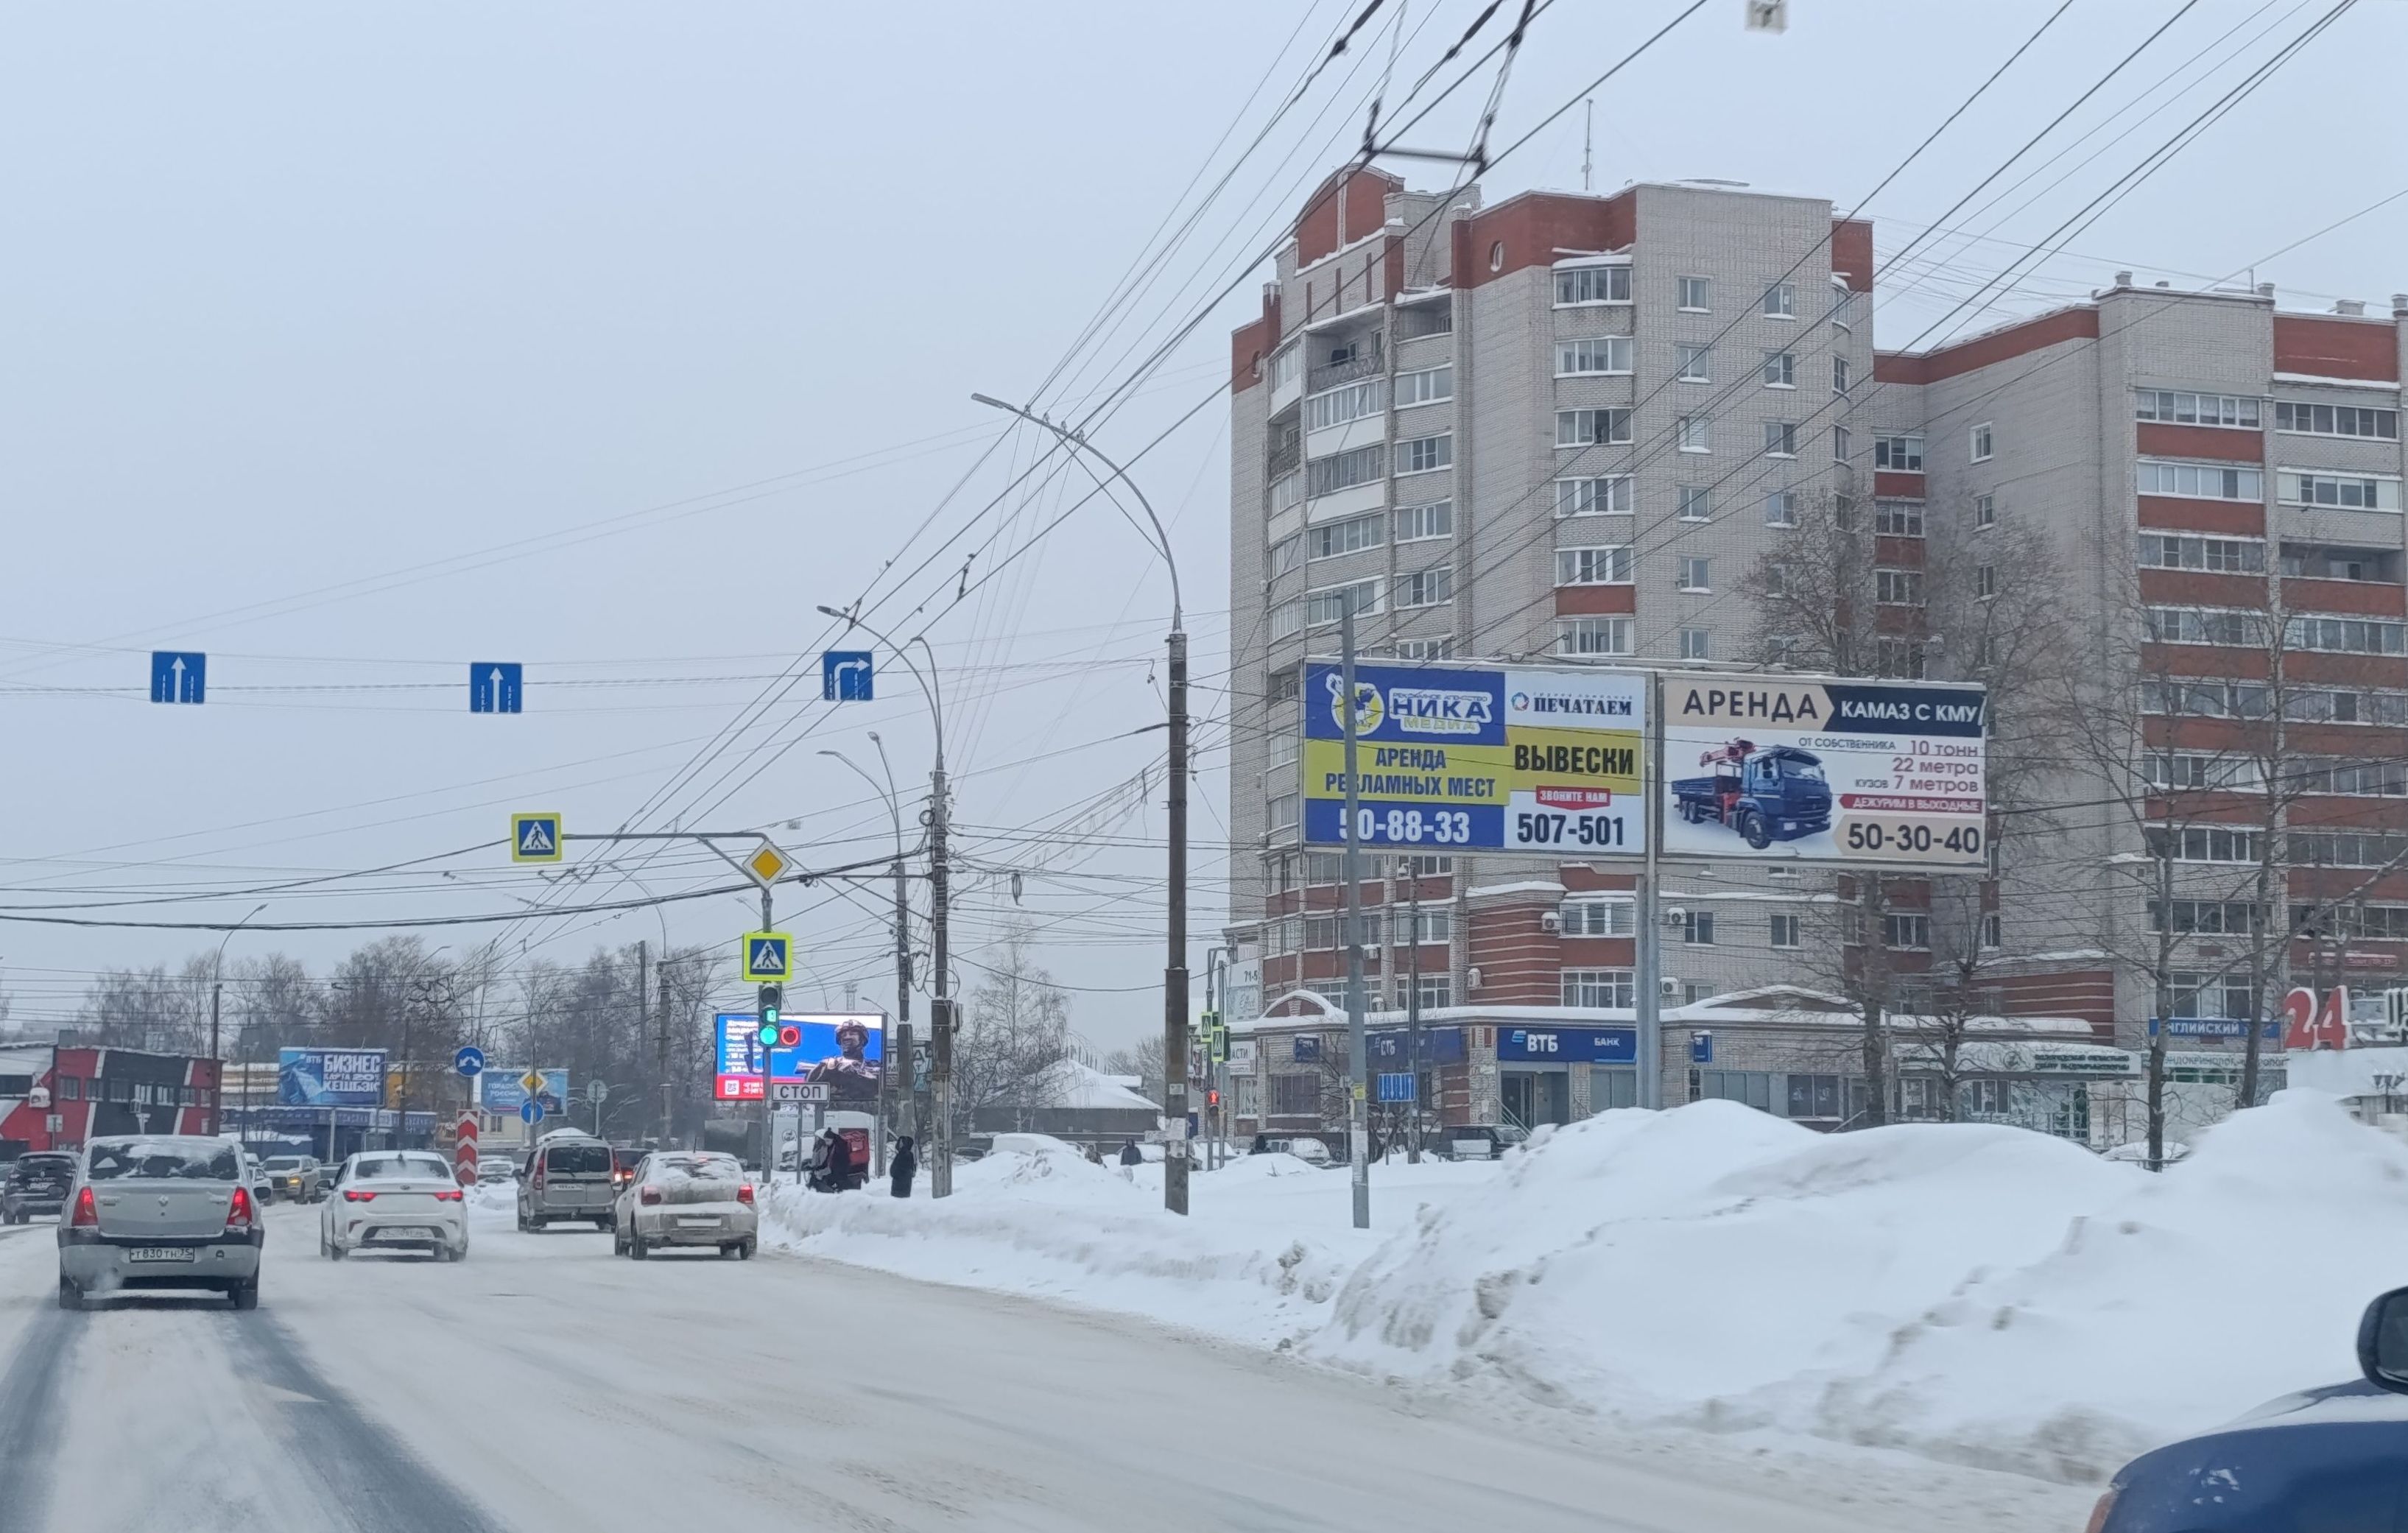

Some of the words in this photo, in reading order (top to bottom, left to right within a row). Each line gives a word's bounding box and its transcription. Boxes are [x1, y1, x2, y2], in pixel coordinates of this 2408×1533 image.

[1393, 697, 1487, 719] НИКА
[1534, 697, 1632, 716] ПЕЧАТАЕМ
[1683, 689, 1818, 723] АРЕНДА
[1842, 701, 1910, 720] КАМАЗ
[1915, 704, 1930, 721] С
[1935, 705, 1978, 722] КМУ
[1404, 717, 1476, 730] МЕДИА
[1798, 737, 1814, 747] ОТ
[1814, 738, 1896, 750] СОБСТВЕННИКА
[1911, 740, 1929, 755] 10
[1935, 744, 1978, 757] тонн
[1376, 747, 1446, 772] АРЕНДА
[1515, 744, 1633, 775] ВЫВЕСКИ
[1893, 757, 1914, 772] 22
[1920, 761, 1978, 778] метра
[1326, 773, 1443, 796] РЕЛАМНЫХ
[1448, 777, 1496, 797] МЕСТ
[1894, 775, 1904, 789] 7
[1909, 778, 1978, 794] метров
[1540, 790, 1583, 802] ЗВОНИТЕ
[1586, 792, 1608, 803] НАМ
[1853, 797, 1906, 809] ДЕЖУРИМ
[1909, 799, 1915, 808] В
[1917, 799, 1979, 811] ВЫХОДНЫЕ
[1517, 813, 1624, 846] 507-501
[1848, 823, 1980, 854] 50-30-40
[2168, 1021, 2239, 1035] НГЛИЙСКИЙ
[2284, 985, 2351, 1051] 24
[1527, 1034, 1559, 1052] ВТБ
[1594, 1037, 1620, 1047] БАНК
[323, 1054, 381, 1074] БИЗНЕС
[780, 1086, 821, 1099] СТОП
